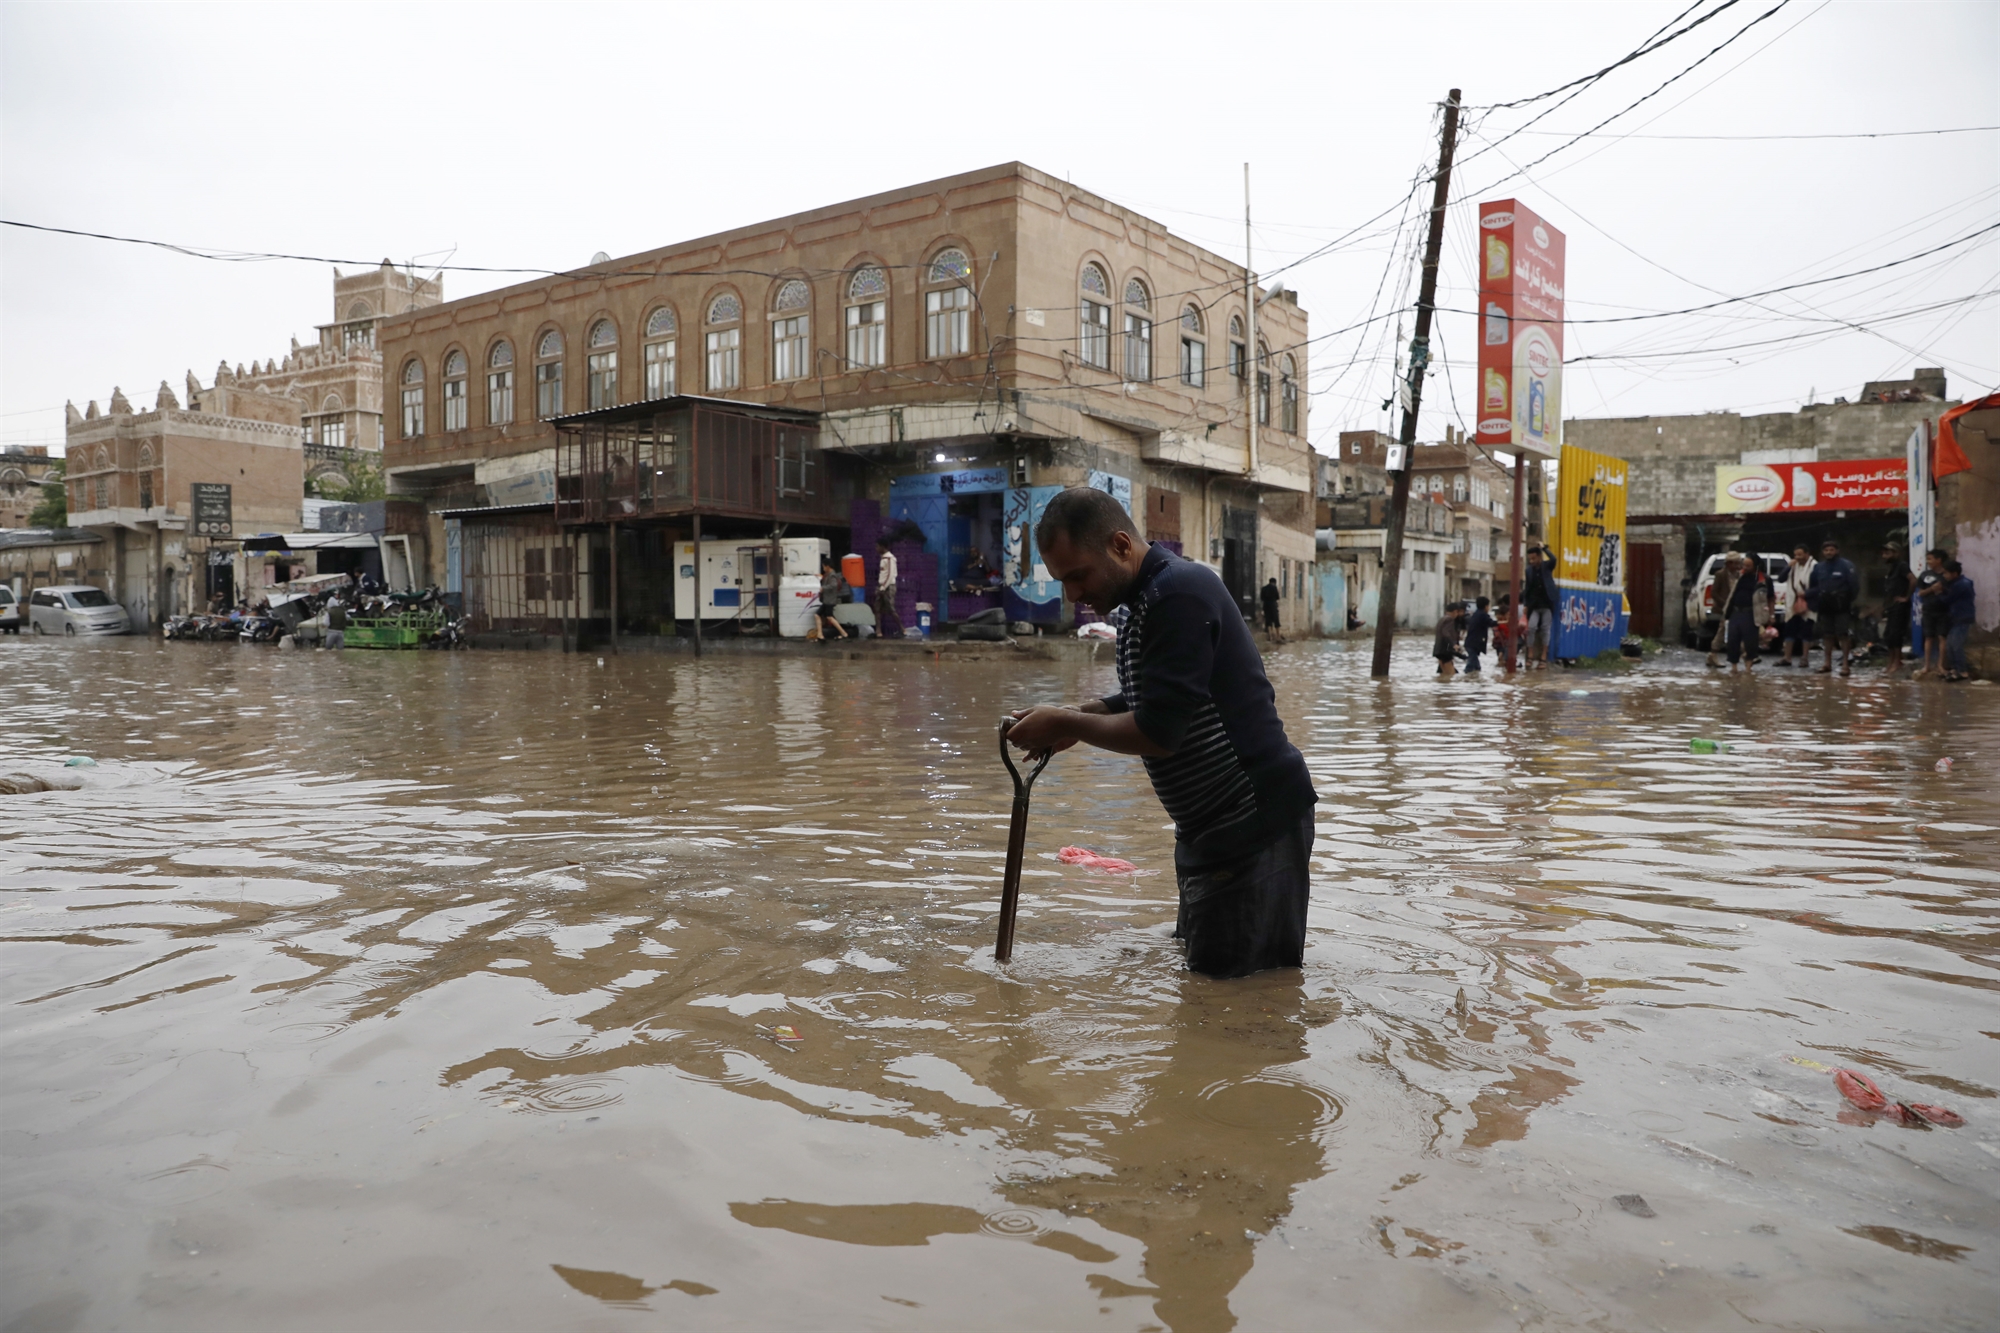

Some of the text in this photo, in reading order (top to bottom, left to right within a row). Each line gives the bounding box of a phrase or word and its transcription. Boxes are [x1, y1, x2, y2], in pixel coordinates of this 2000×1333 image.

[1483, 215, 1513, 225] SINTEC
[1529, 350, 1549, 368] SINTEC
[1481, 422, 1511, 430] SINTEC
[1734, 483, 1770, 494] سنتك
